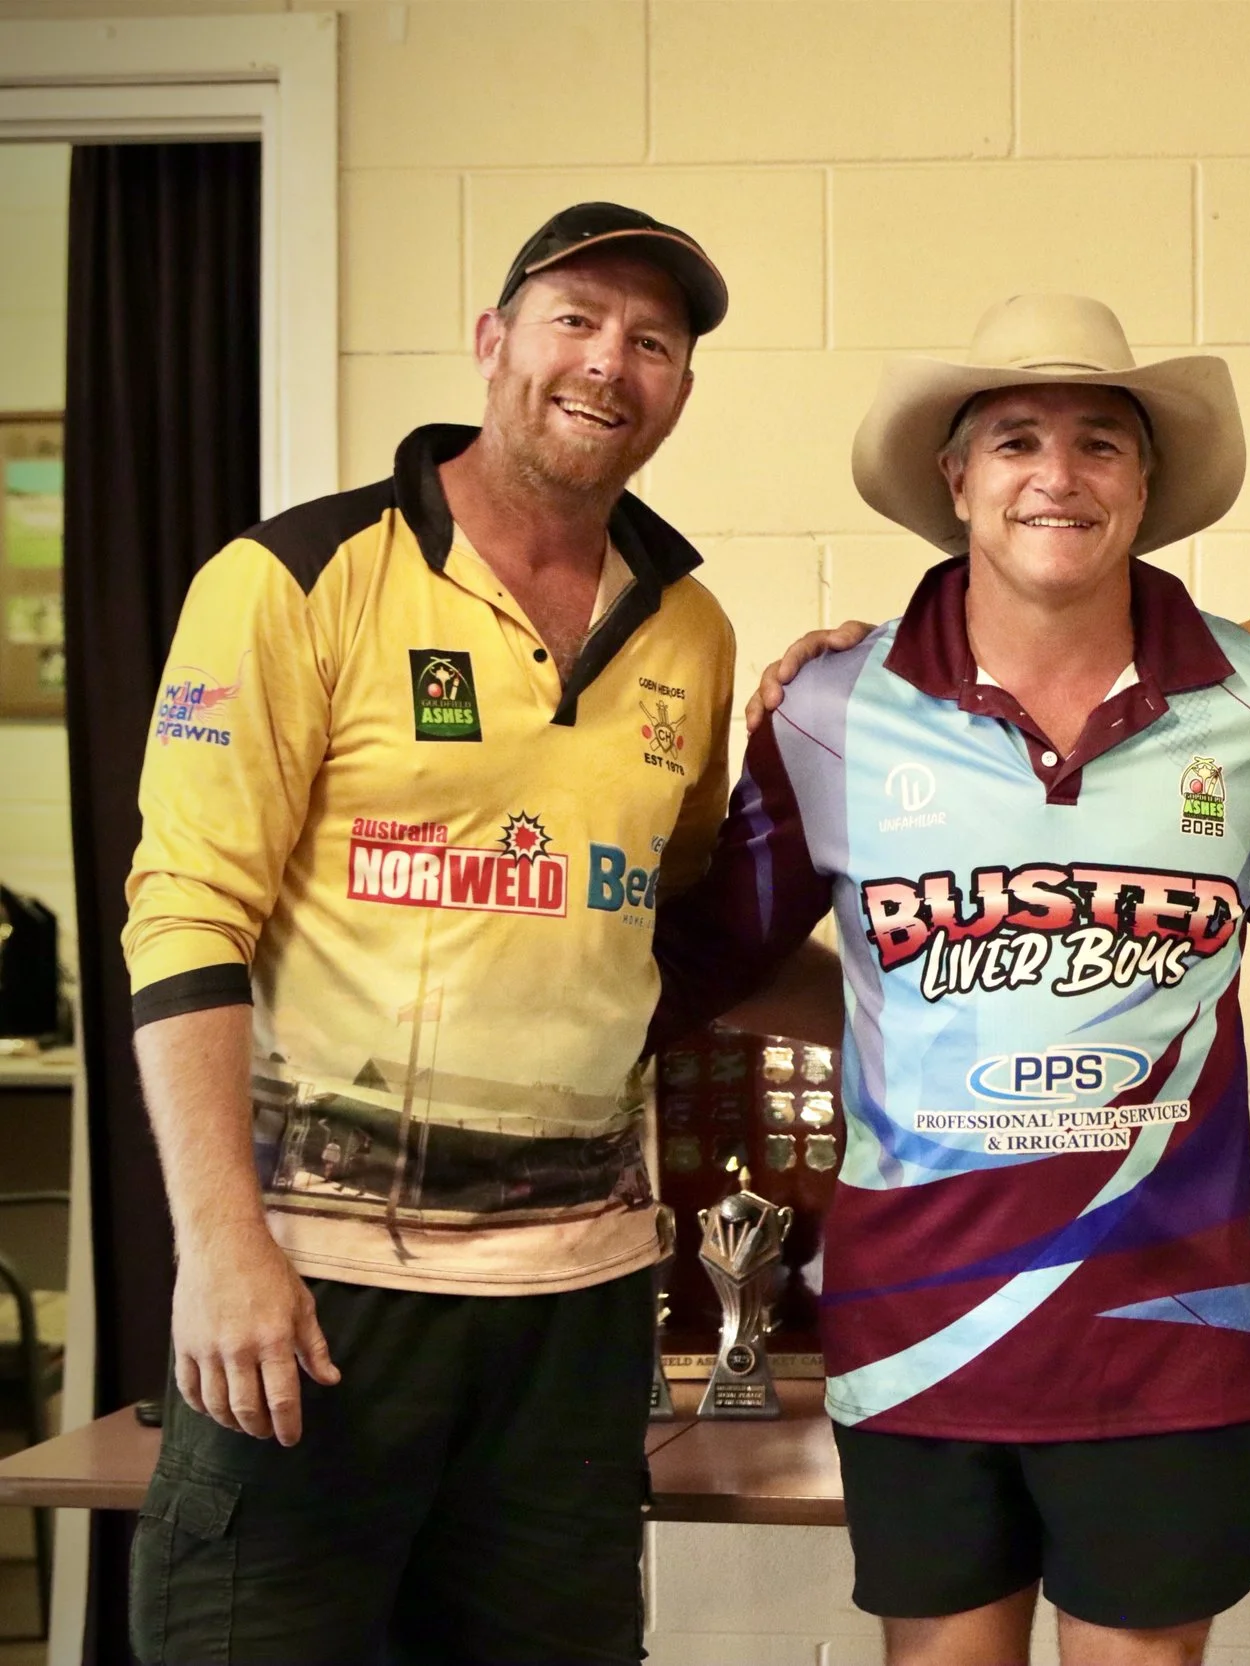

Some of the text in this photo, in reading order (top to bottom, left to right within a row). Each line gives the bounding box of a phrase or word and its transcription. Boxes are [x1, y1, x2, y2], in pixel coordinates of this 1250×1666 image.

[658, 683, 686, 700] HEROES
[421, 707, 474, 725] ASHES
[156, 720, 231, 746] prawns
[658, 728, 672, 744] CH
[644, 751, 663, 769] EST
[1183, 798, 1225, 818] ASHES
[351, 816, 449, 844] australia
[1181, 818, 1225, 838] 2025
[862, 865, 1246, 970] BUSTED
[922, 929, 1048, 1000] LIVER
[1014, 1054, 1103, 1092] PPS
[916, 1103, 1189, 1130] PROFESSIONAL PUMP SERVICES
[987, 1131, 1128, 1151] & IRRIGATION
